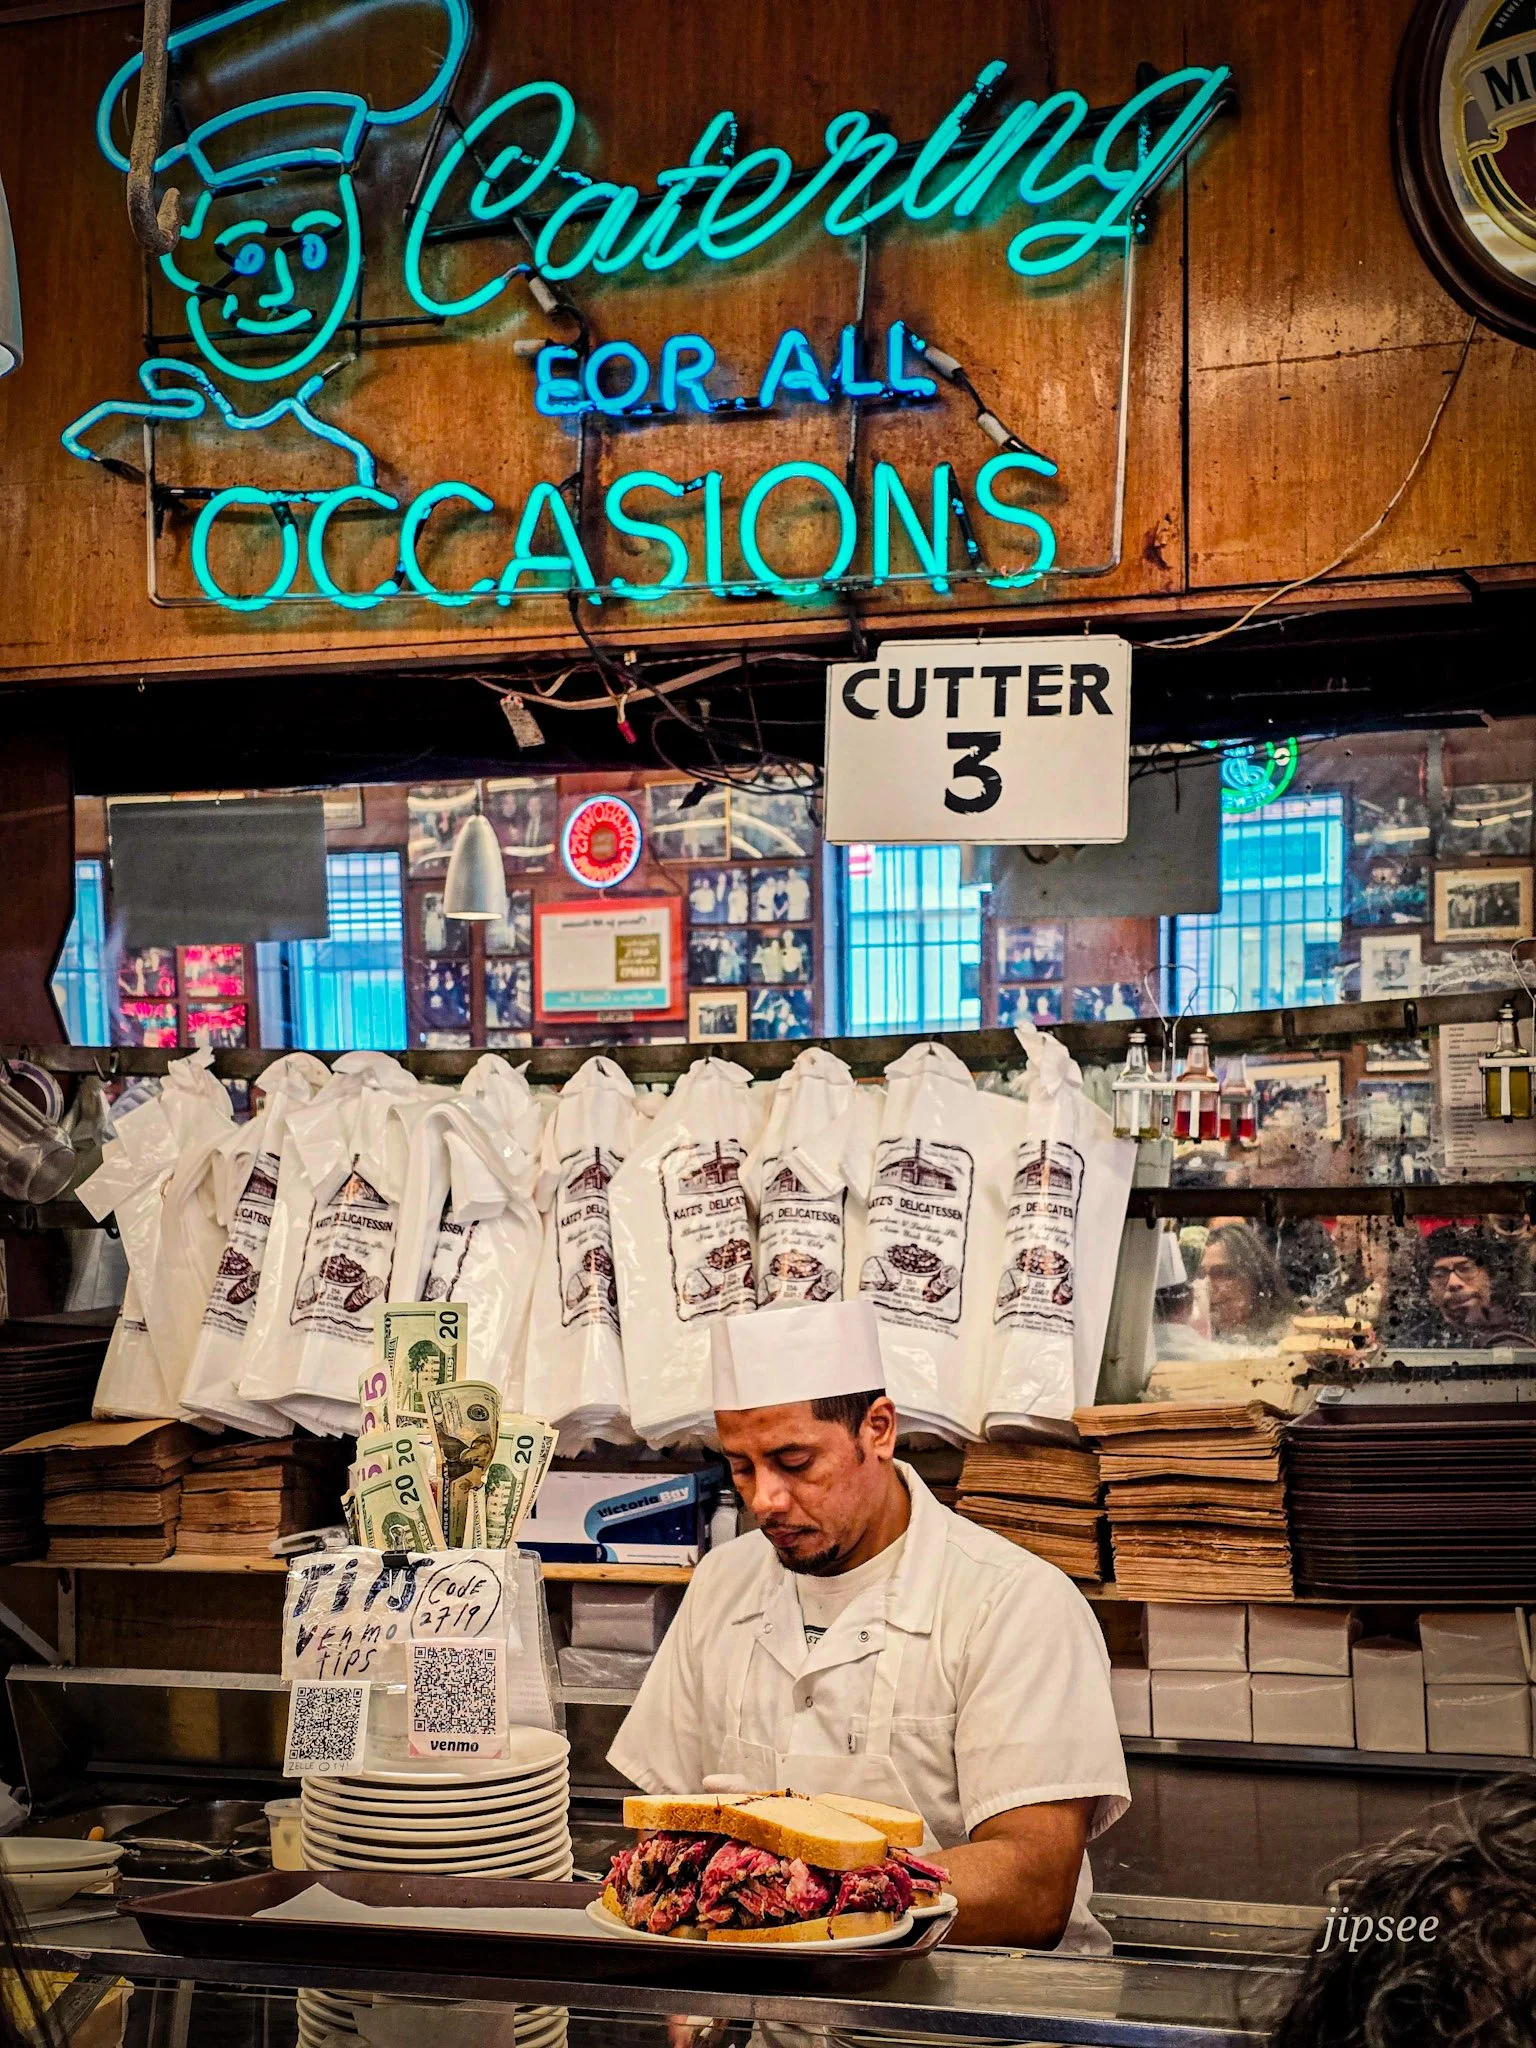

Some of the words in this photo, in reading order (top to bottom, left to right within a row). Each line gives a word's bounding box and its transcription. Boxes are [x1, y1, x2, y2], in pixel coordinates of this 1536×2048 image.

[404, 59, 1233, 317] Catering
[535, 334, 716, 416] FOR
[757, 321, 938, 408] ALL
[191, 452, 1058, 611] OCCASIONS
[841, 663, 1114, 720] CUTTER
[943, 731, 1002, 815] 3
[900, 1197, 963, 1222] DELICATESSEN
[439, 1311, 459, 1340] 20
[365, 1372, 387, 1401] 5
[514, 1435, 535, 1465] 20
[395, 1474, 420, 1506] 20
[419, 1603, 481, 1634] 2719
[430, 1739, 479, 1753] venmo
